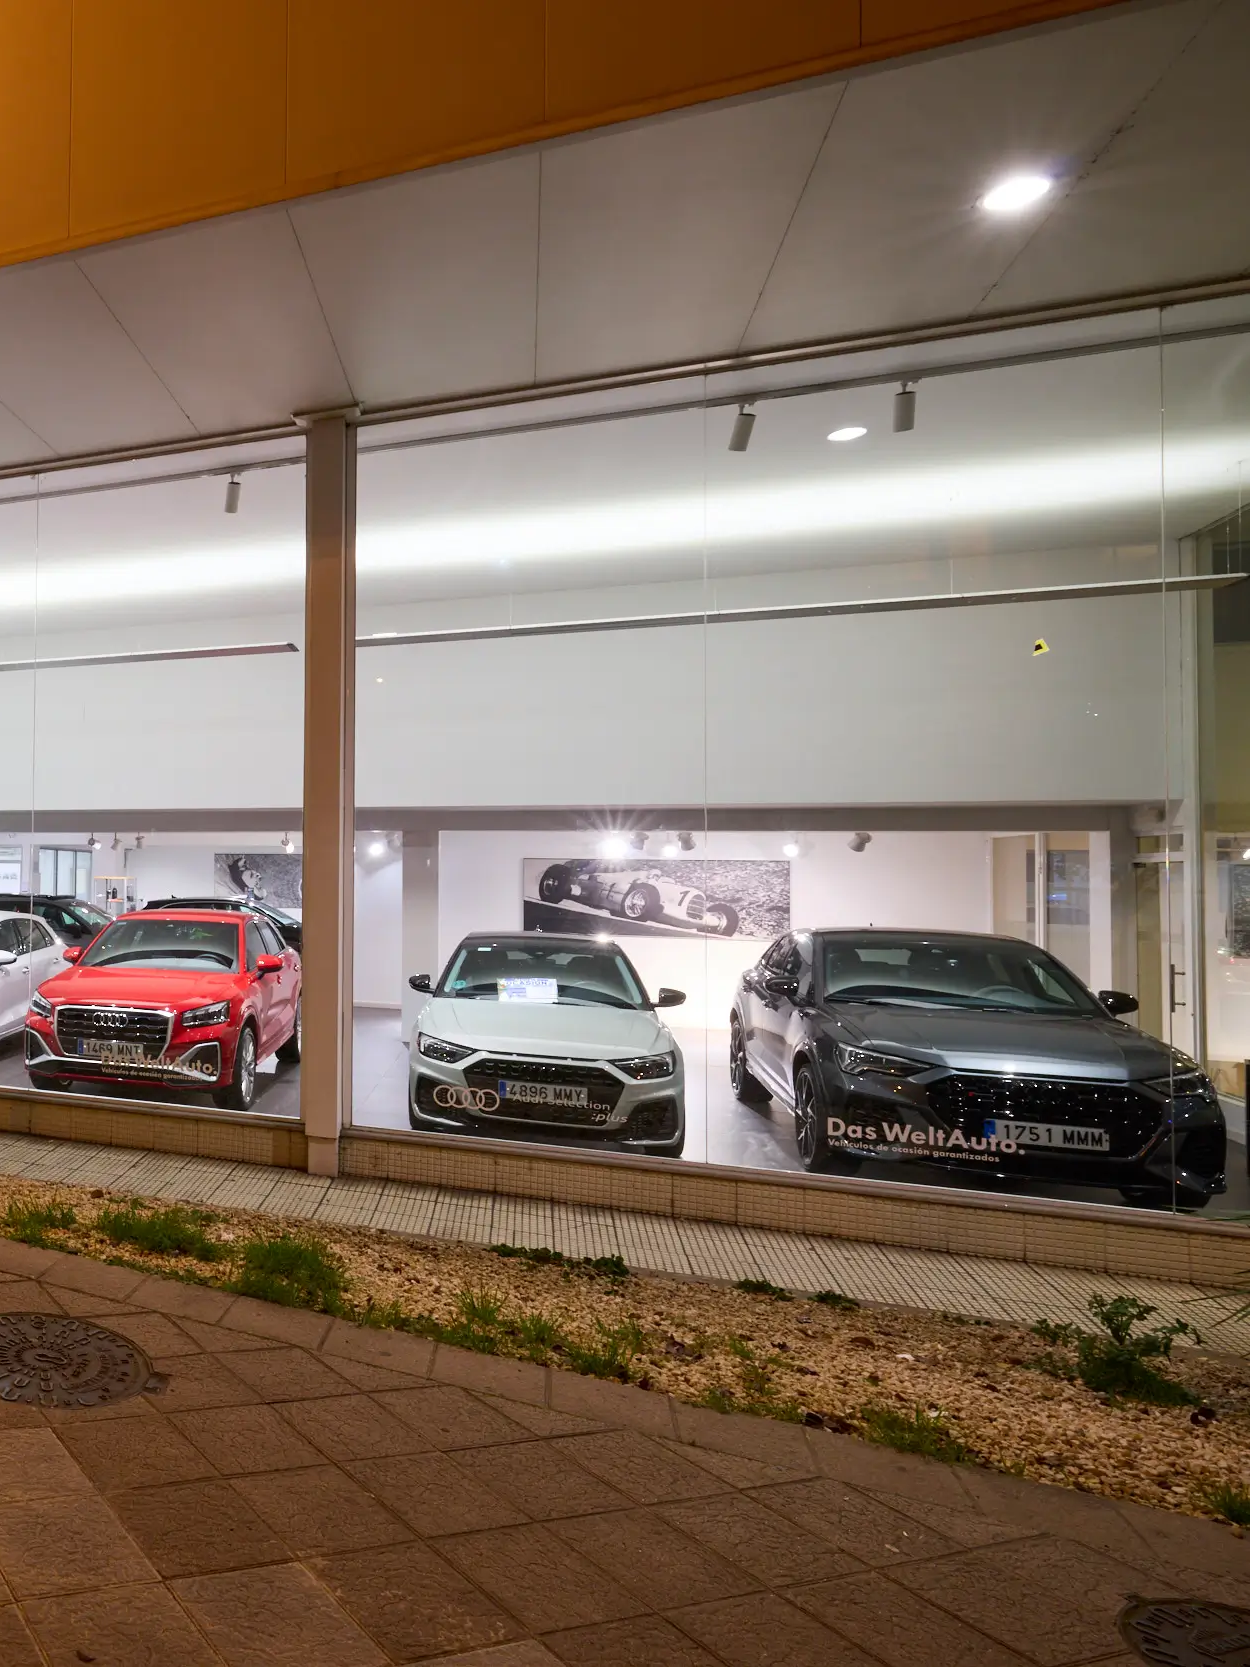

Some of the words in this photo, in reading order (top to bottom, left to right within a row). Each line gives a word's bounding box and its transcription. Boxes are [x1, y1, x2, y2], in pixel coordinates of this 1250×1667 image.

[117, 1043, 141, 1058] MNT
[509, 1083, 548, 1099] 4896
[553, 1087, 582, 1102] MMY
[547, 1094, 611, 1111] Selection
[827, 1117, 877, 1140] Das
[881, 1121, 1026, 1155] WeltAuto.
[1003, 1124, 1053, 1143] 1751
[1062, 1129, 1103, 1148] MMM
[828, 1138, 874, 1150] Vehículos
[876, 1143, 889, 1152] de
[891, 1145, 930, 1156] ocasión
[932, 1149, 1000, 1163] garantizados
